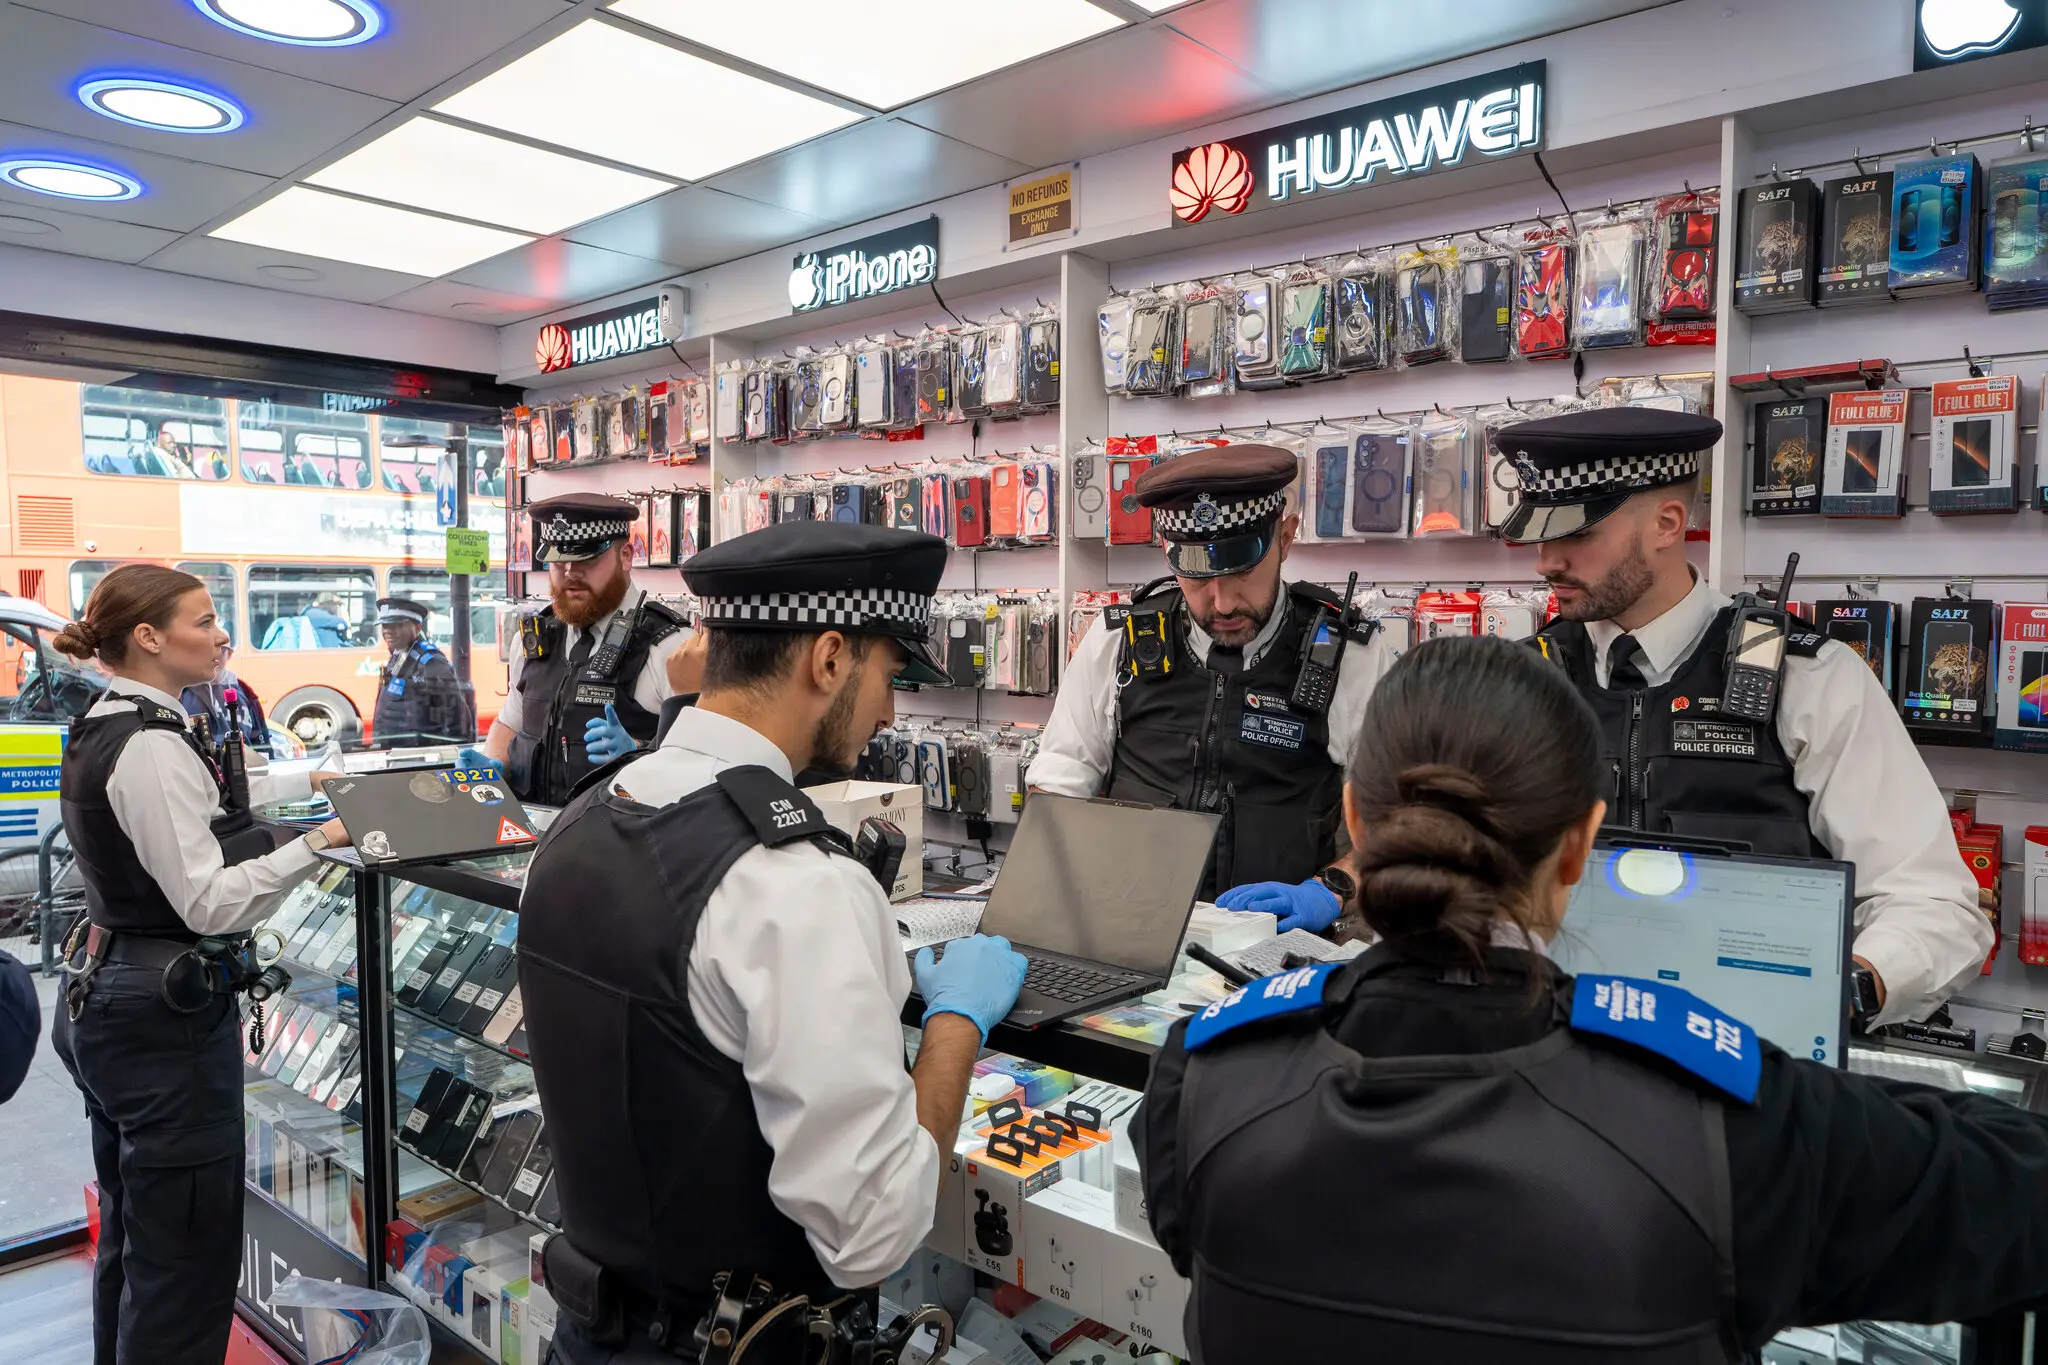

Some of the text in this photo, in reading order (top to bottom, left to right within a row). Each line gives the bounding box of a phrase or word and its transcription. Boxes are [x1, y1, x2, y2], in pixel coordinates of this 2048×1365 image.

[1268, 83, 1541, 200] HUAWEI
[1012, 179, 1068, 208] NO REFUNDS
[1757, 187, 1791, 202] SAFI
[1841, 180, 1878, 195] SAFI
[1021, 205, 1059, 225] EXCHANGE
[1030, 220, 1049, 234] ONLY
[825, 245, 936, 304] iPhone
[1753, 267, 1777, 278] Quality
[1838, 263, 1862, 273] Quality
[1772, 405, 1804, 417] SAFI
[1769, 483, 1792, 492] Quality
[1832, 607, 1868, 618] SAFI
[1931, 608, 1969, 620] SAFI
[2023, 623, 2046, 638] FULL
[985, 643, 993, 677] Quality
[1925, 691, 1951, 700] Quality
[1264, 719, 1299, 731] METROPOLITAN
[1268, 725, 1293, 736] POLICE
[1697, 724, 1751, 733] METROPOLITAN
[1241, 731, 1300, 749] POLICE OFFICER
[1704, 732, 1744, 740] POLICE
[1674, 742, 1755, 755] POLICE OFFICER
[440, 768, 494, 783] 1927
[11, 778, 61, 789] POLICE
[770, 798, 794, 814] CN
[772, 808, 808, 829] 2207
[1686, 1010, 1713, 1040] CN
[986, 1258, 1001, 1272] £55
[1050, 1285, 1070, 1300] £120
[511, 1302, 519, 1331] £20
[1130, 1322, 1152, 1339] £180
